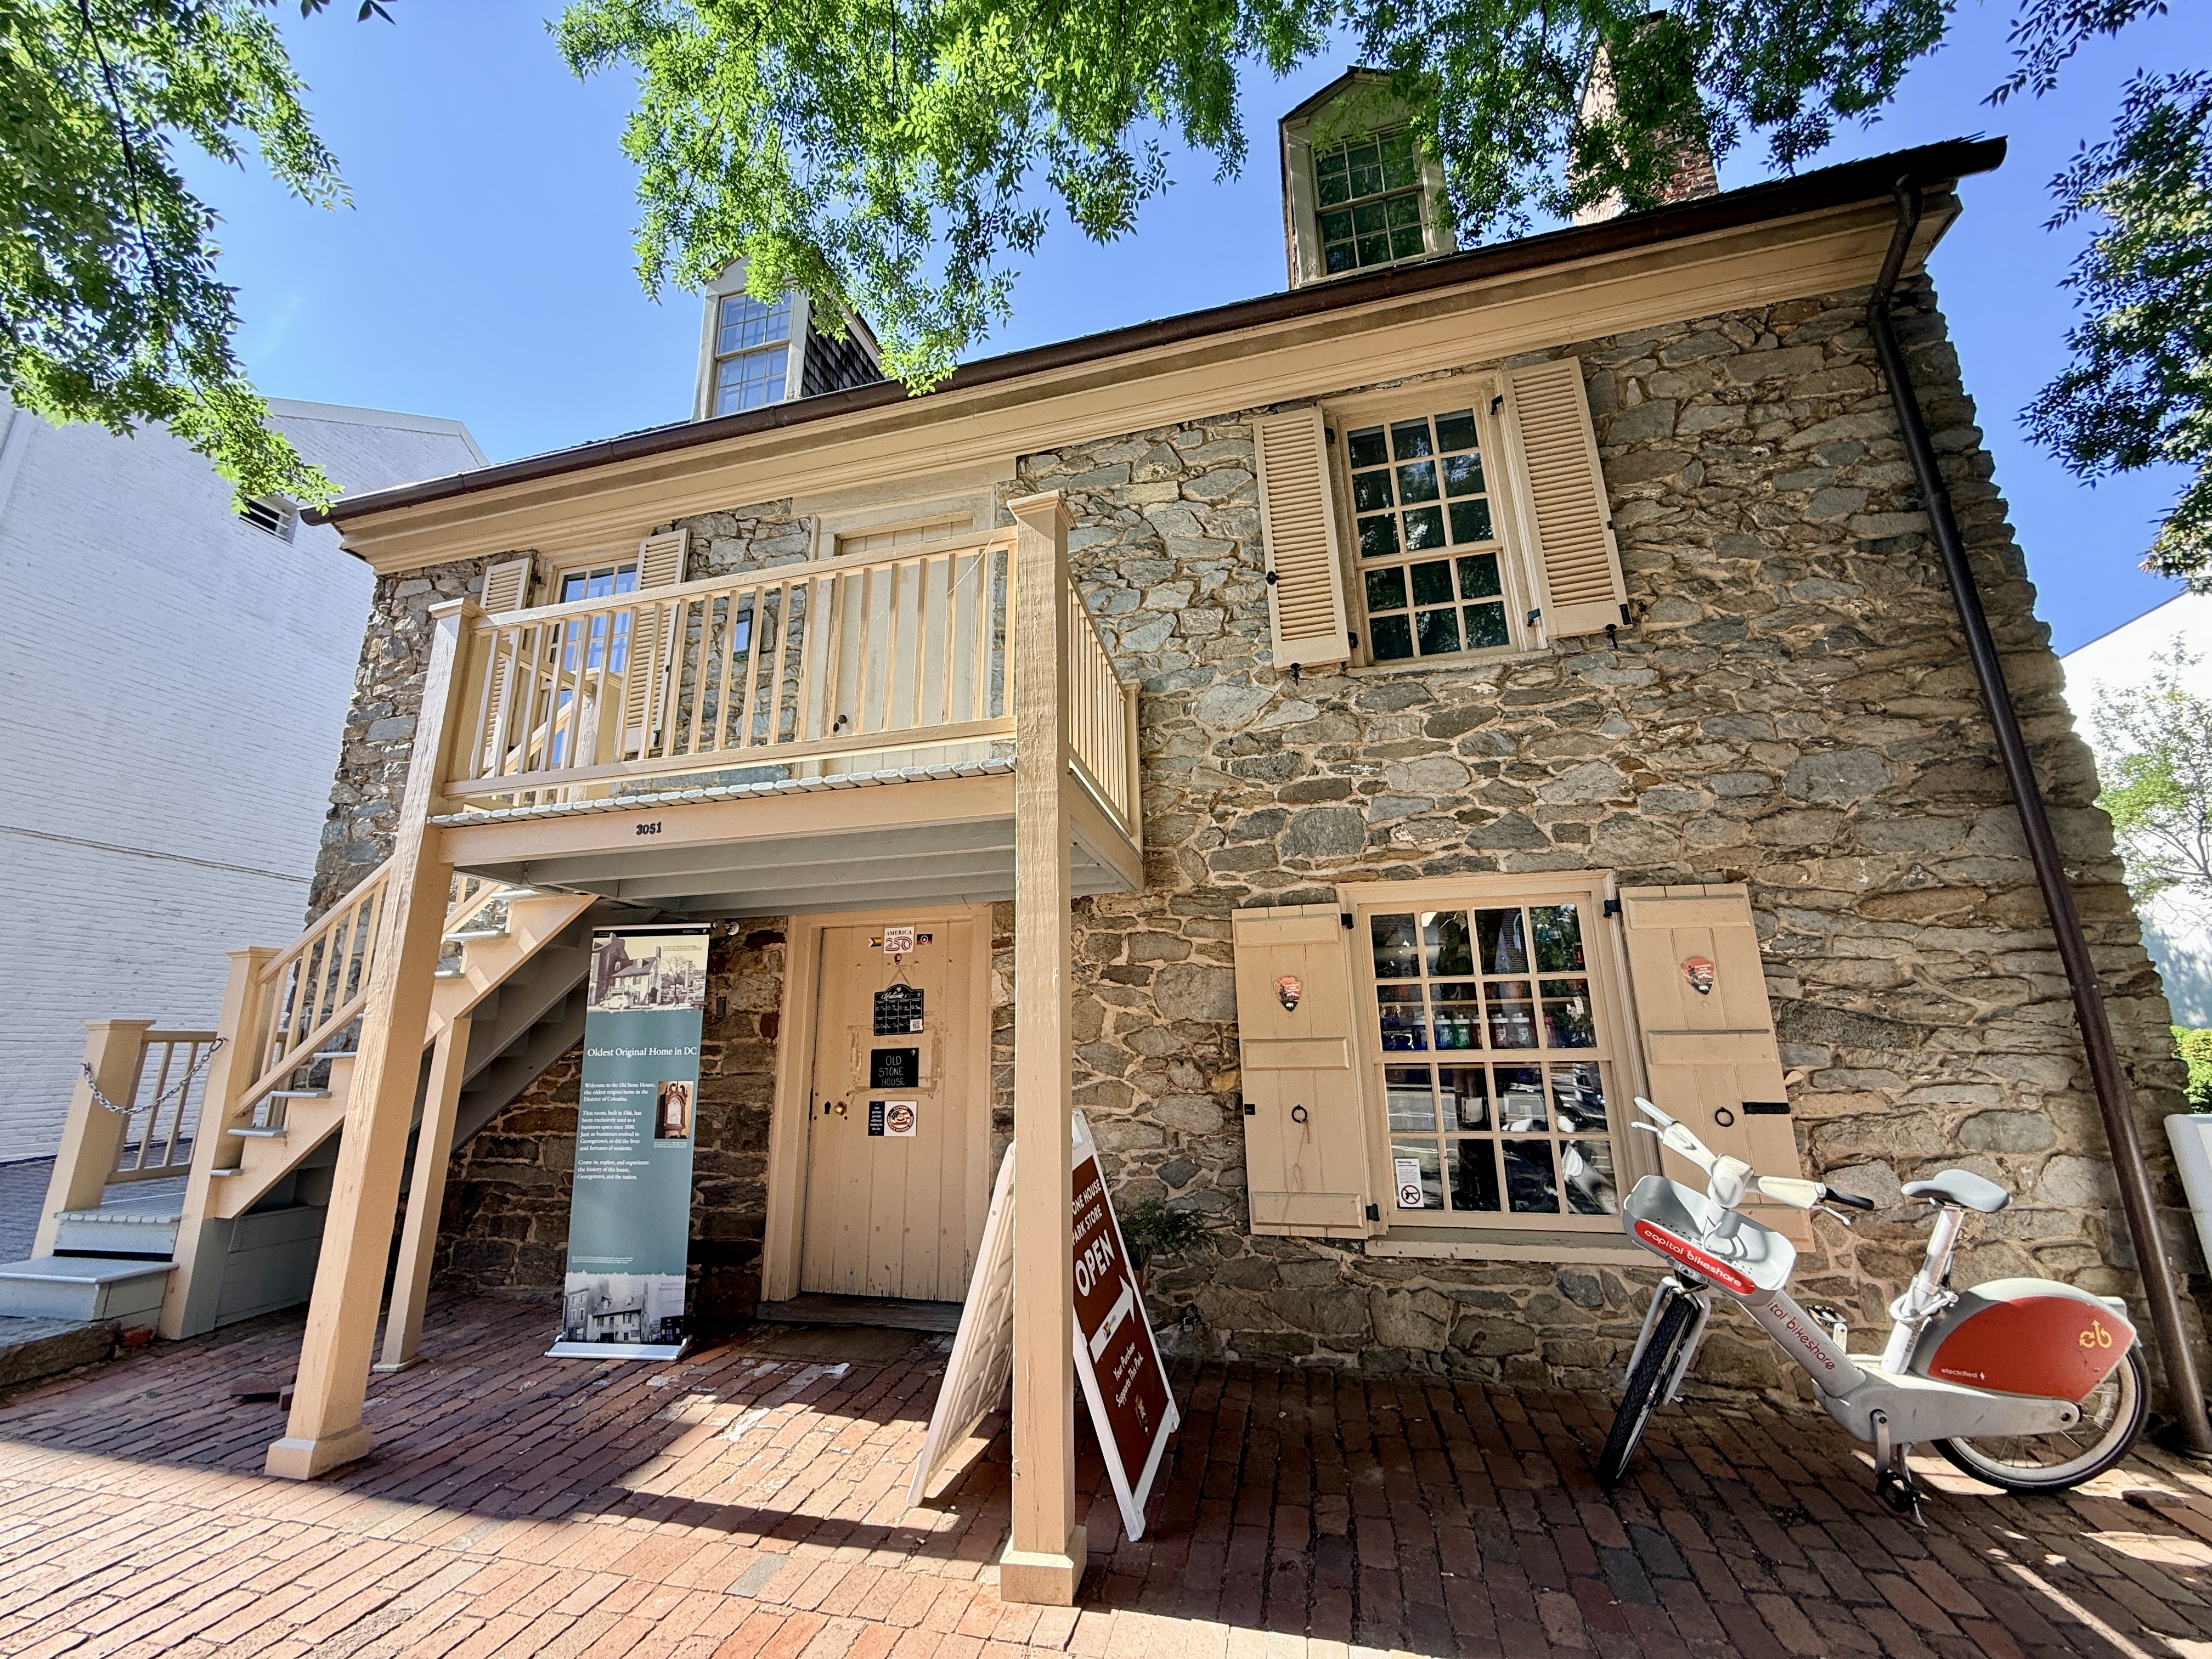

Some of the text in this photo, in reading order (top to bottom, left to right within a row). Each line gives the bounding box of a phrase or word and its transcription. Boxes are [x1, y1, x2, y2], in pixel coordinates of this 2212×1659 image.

[636, 821, 662, 835] 3051
[885, 936, 912, 951] 250
[587, 1048, 613, 1057] Oldest
[616, 1048, 647, 1058] Original
[684, 1047, 697, 1055] DC
[886, 1056, 901, 1065] OLD
[878, 1067, 904, 1077] STONE
[882, 1077, 905, 1086] HOUSE
[1072, 1178, 1102, 1215] ONE HOUSE
[1085, 1204, 1103, 1231] STORE
[1075, 1229, 1115, 1297] OPEN
[1644, 1230, 1742, 1286] capital bikeshare
[1767, 1300, 1835, 1369] ital bikeshare
[1113, 1342, 1136, 1381] Your Purchase
[1942, 1368, 1977, 1378] electrified
[1115, 1378, 1131, 1408] Supports
[1128, 1364, 1137, 1381] This
